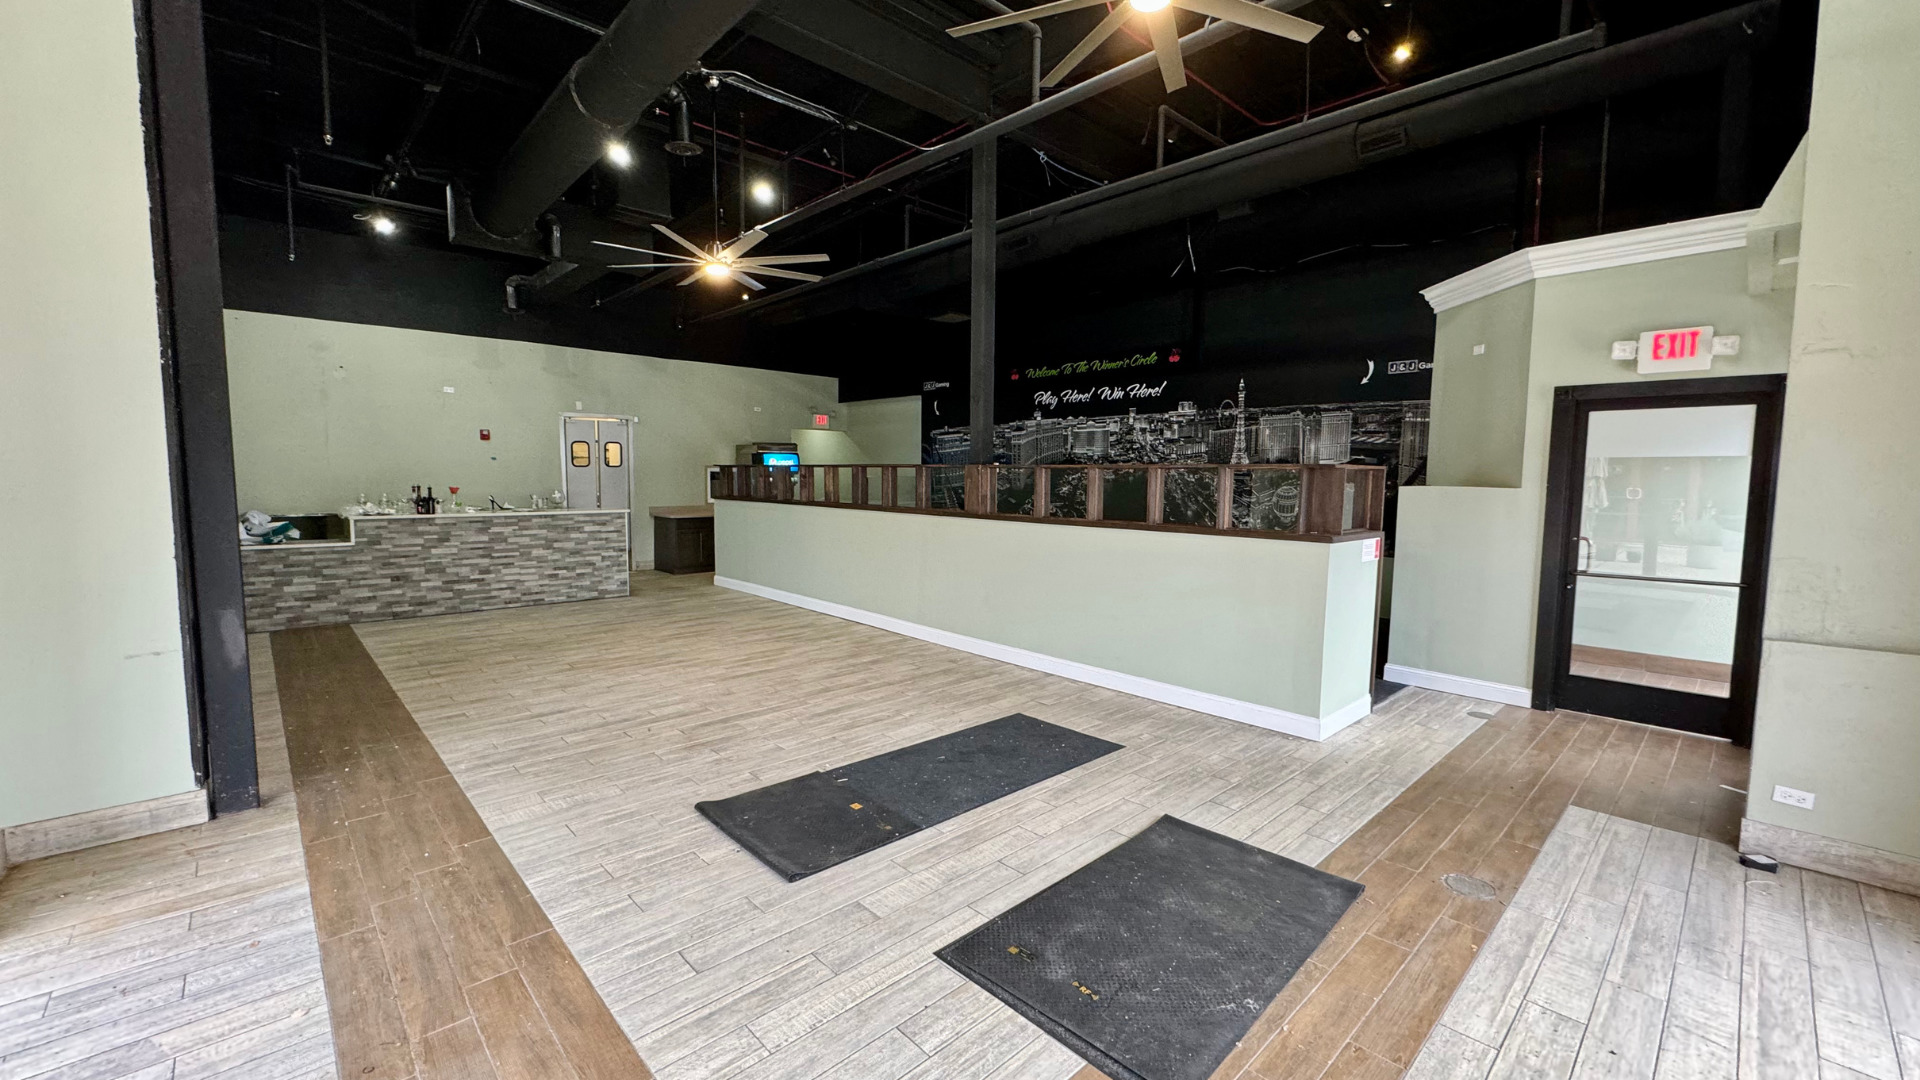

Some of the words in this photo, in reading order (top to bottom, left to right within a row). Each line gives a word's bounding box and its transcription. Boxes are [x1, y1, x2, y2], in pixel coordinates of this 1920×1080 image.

[1652, 329, 1702, 360] EXIT
[1025, 366, 1060, 378] Welcome
[1061, 363, 1073, 375] To
[1073, 360, 1089, 373] The
[1090, 357, 1129, 371] Winner's
[1130, 352, 1158, 367] Circle
[1033, 391, 1058, 409] Play
[1060, 387, 1095, 403] Here!
[1097, 386, 1124, 400] Win
[1126, 381, 1167, 399] Here!
